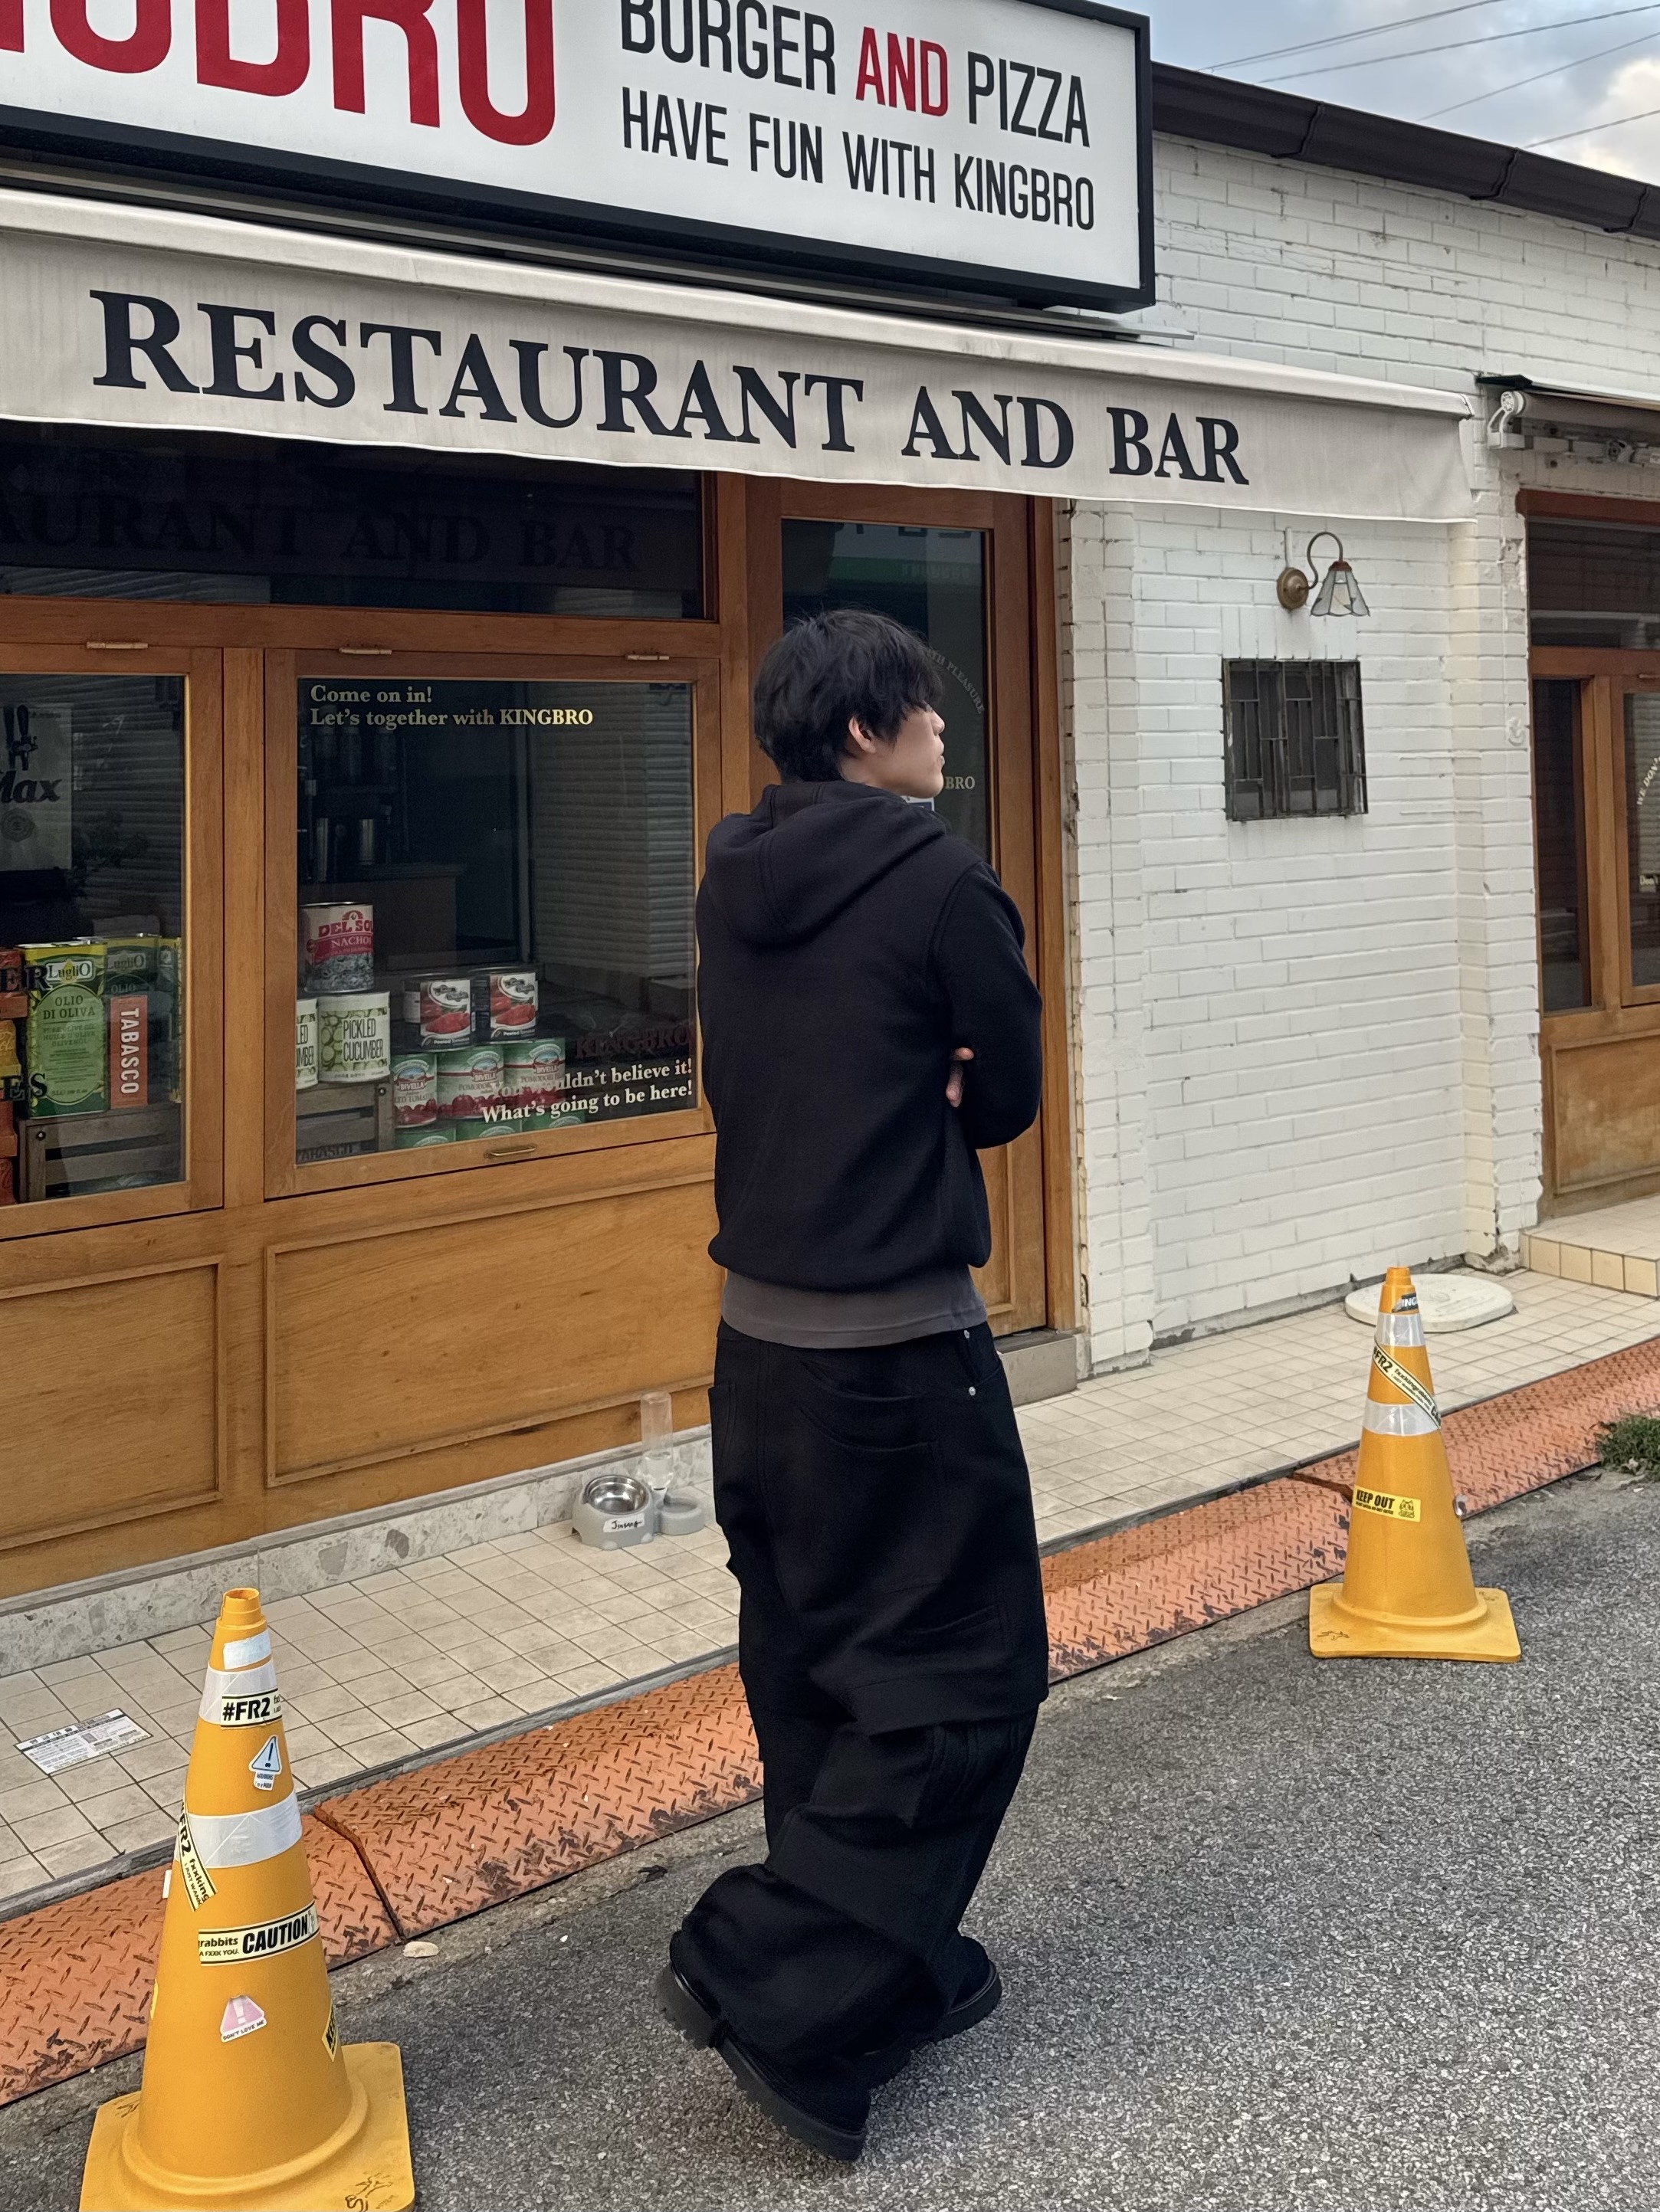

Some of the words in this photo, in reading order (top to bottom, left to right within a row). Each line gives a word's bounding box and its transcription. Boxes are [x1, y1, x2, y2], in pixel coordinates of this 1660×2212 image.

[621, 0, 836, 95] BURGER
[855, 26, 950, 117] AND
[967, 51, 1091, 148] PIZZA
[622, 87, 729, 168] HAVE
[749, 112, 823, 184] FUN
[842, 131, 936, 204] WITH
[954, 152, 1095, 231] KINGBRO
[90, 289, 864, 453] RESTAURANT
[901, 385, 1074, 469] AND
[1106, 406, 1250, 485] BAR
[310, 684, 370, 703] Come
[376, 690, 402, 703] on
[406, 687, 432, 703] in!
[366, 709, 448, 731] together
[453, 708, 495, 726] with
[500, 709, 593, 726] KINGBRO
[319, 920, 353, 938] DEL
[355, 919, 372, 932] SO
[43, 1009, 55, 1020] DI
[59, 1006, 96, 1019] OLIVA
[55, 995, 84, 1007] OLIO
[343, 1018, 376, 1040] PICKLED
[120, 1008, 139, 1094] TABASCO
[343, 1038, 384, 1062] CUCUMBER
[612, 1065, 671, 1084] believe
[674, 1058, 693, 1076] it!
[550, 1094, 599, 1119] going
[603, 1093, 620, 1108] to
[625, 1088, 645, 1104] be
[650, 1080, 693, 1101] here!
[1356, 1489, 1373, 1504] KEEP
[1374, 1495, 1396, 1509] OUT
[222, 1696, 271, 1722] #FR2
[242, 1914, 309, 1955] CAUTION
